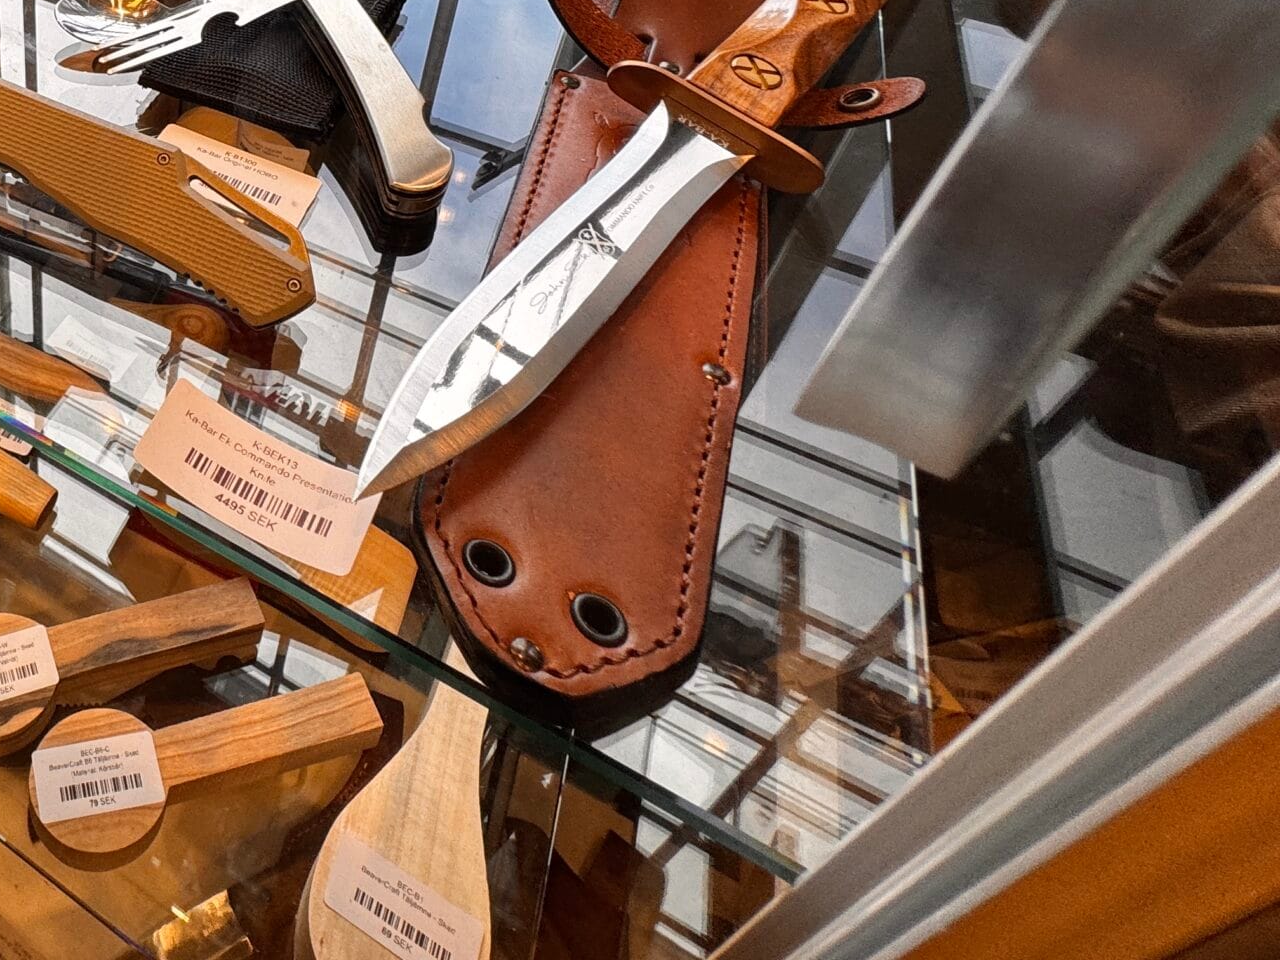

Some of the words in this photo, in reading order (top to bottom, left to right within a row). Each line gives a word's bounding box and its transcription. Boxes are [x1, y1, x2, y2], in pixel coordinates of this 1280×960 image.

[185, 408, 218, 437] Ka-Bar
[217, 432, 232, 445] Ek
[233, 442, 291, 478] Commando
[252, 439, 300, 470] K-BEK13
[249, 466, 276, 487] Knife
[214, 493, 246, 516] 4495
[247, 509, 279, 532] SEK
[0, 685, 16, 695] SEK
[89, 799, 99, 809] 79
[99, 795, 117, 806] SEK
[393, 934, 414, 954] SEK
